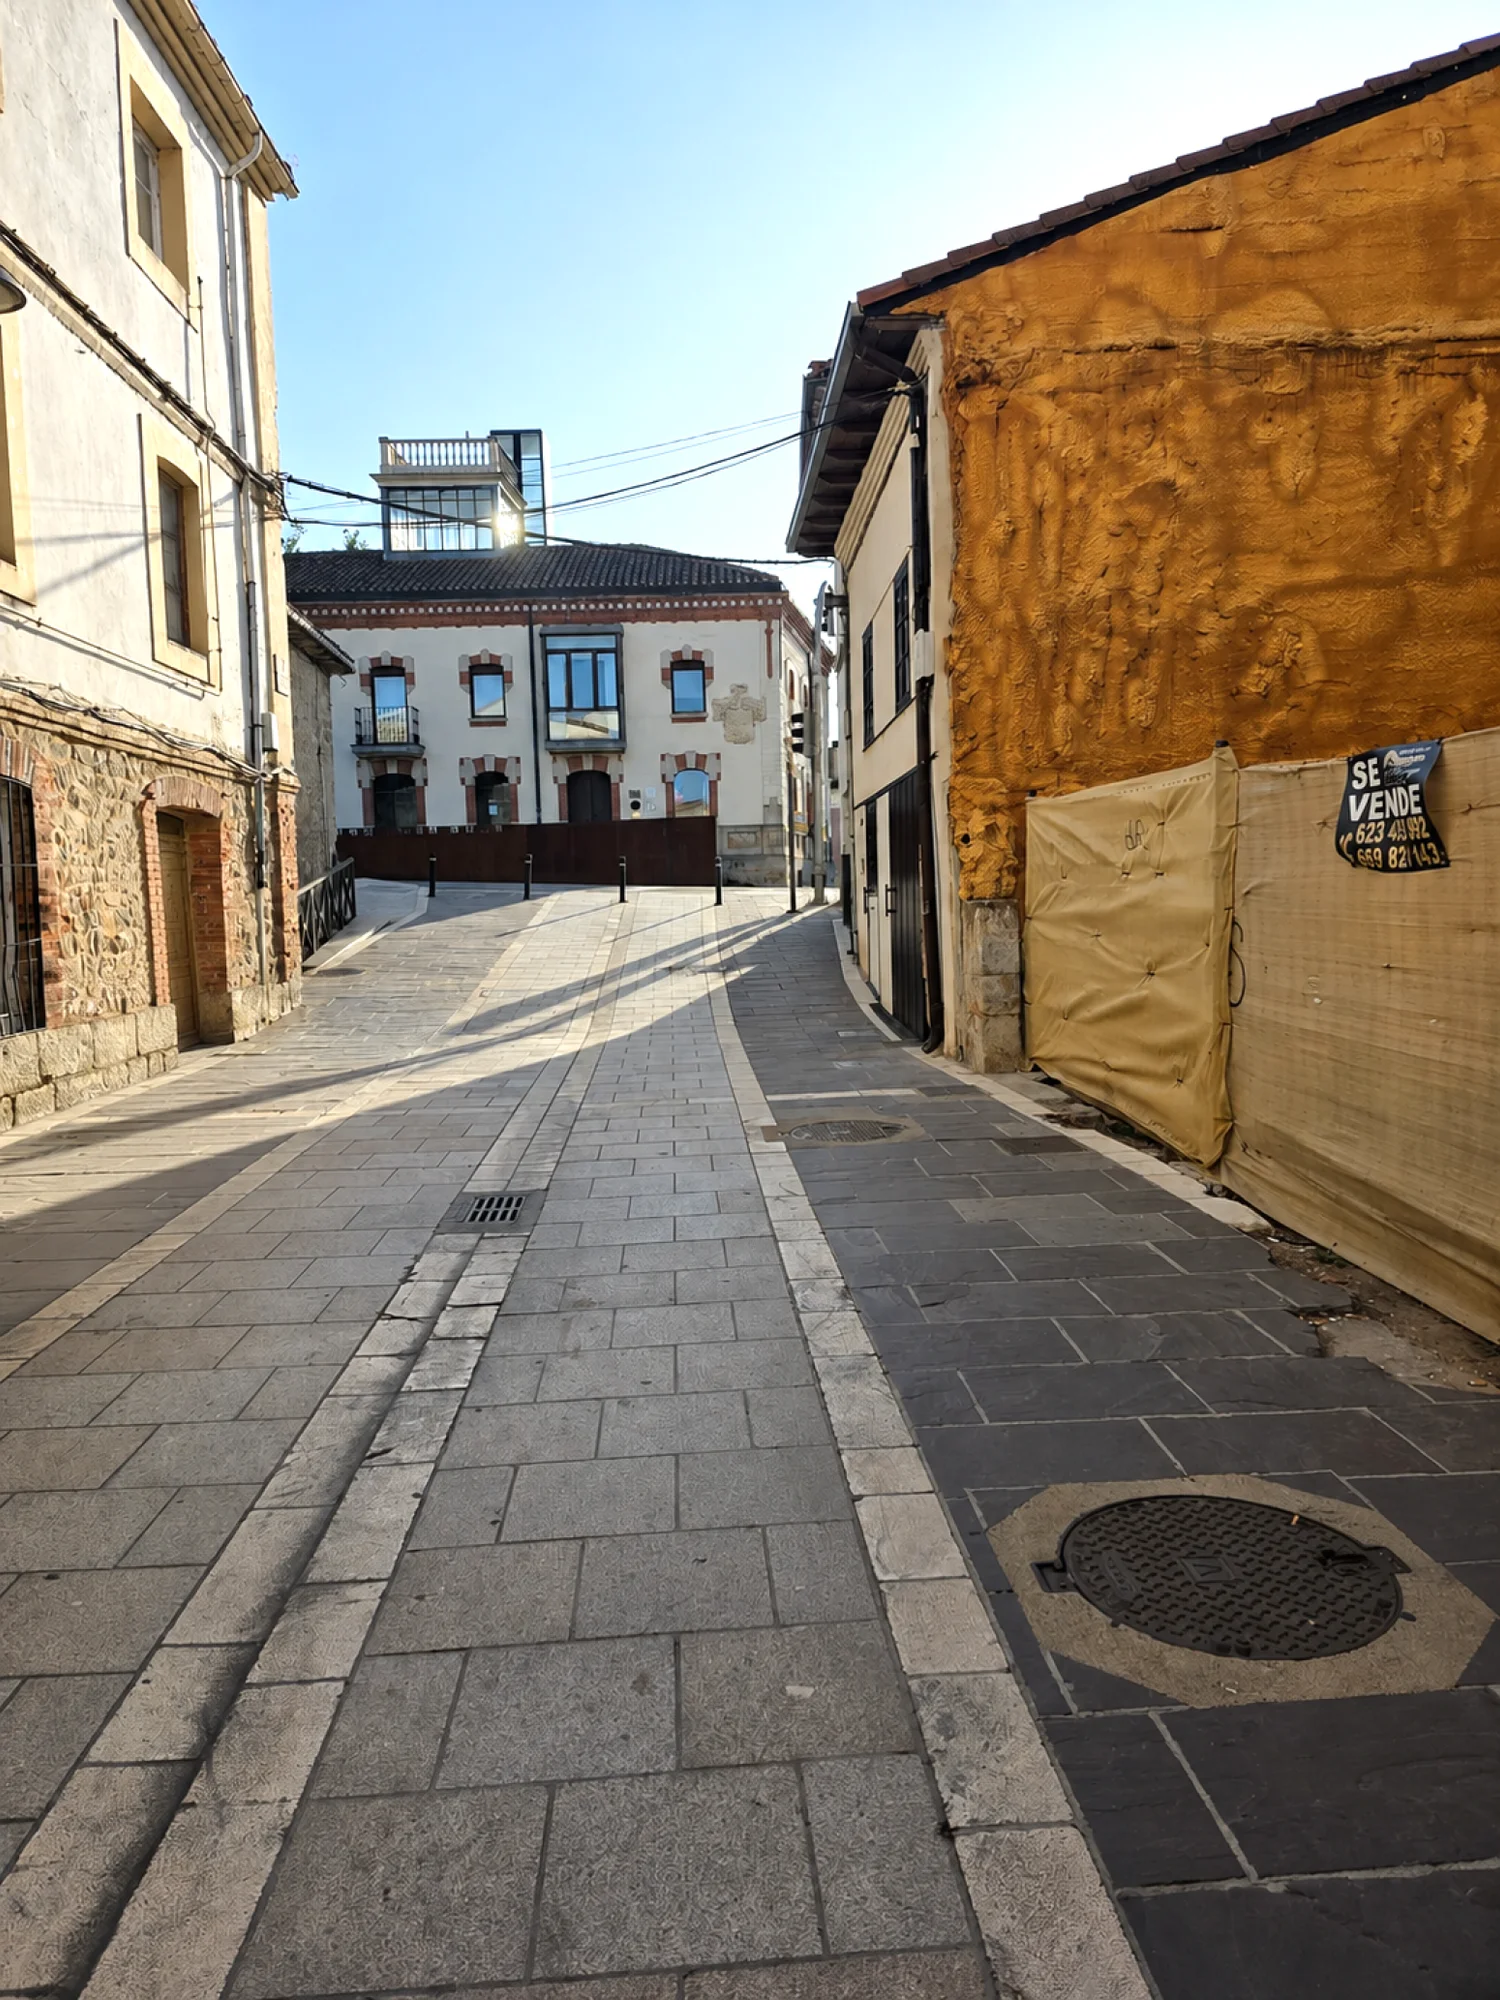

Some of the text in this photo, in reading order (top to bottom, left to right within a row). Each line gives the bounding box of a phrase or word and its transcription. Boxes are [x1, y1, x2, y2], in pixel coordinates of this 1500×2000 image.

[1351, 757, 1381, 790] SE
[1348, 783, 1423, 822] VENDE
[1355, 820, 1385, 845] 623
